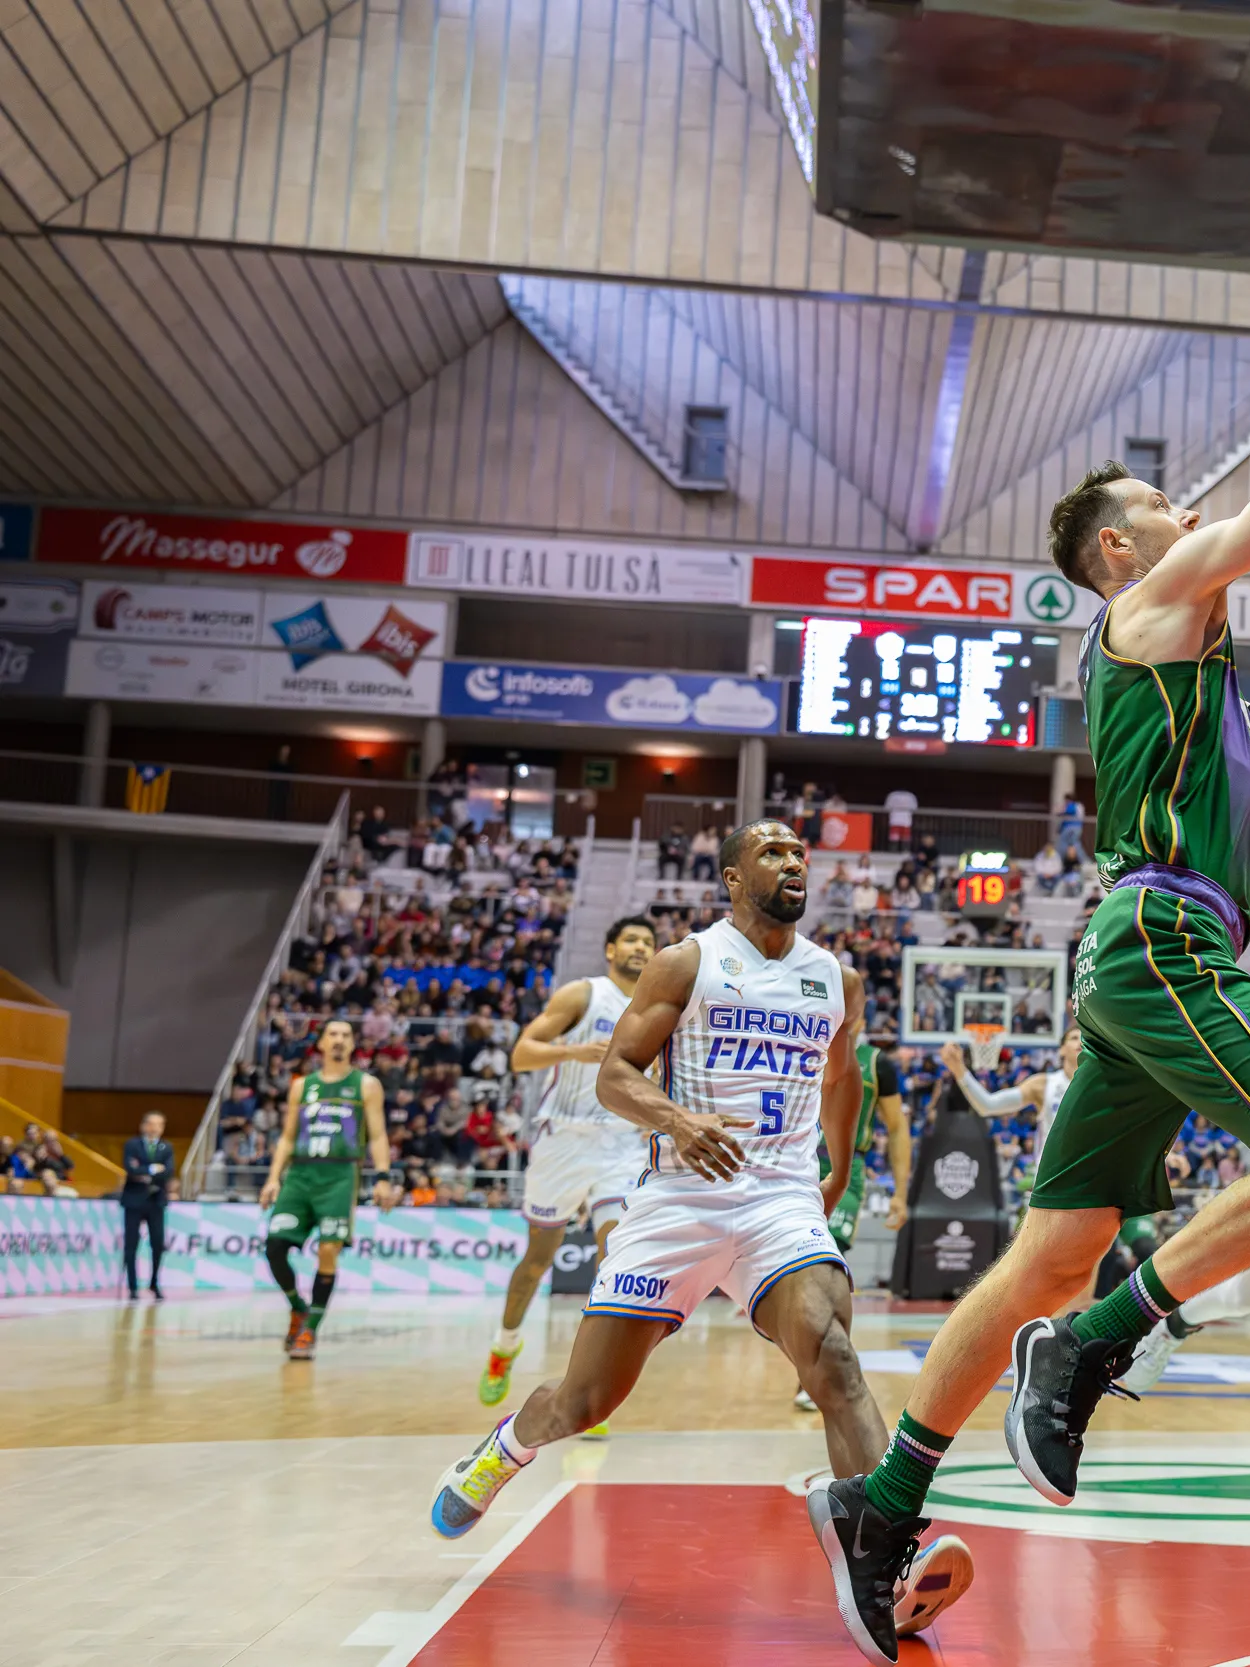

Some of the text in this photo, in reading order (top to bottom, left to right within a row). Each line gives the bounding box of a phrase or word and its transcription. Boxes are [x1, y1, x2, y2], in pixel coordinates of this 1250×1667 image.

[101, 515, 284, 568] Massegur
[465, 546, 662, 594] LLEAL TULSÀ
[824, 567, 1010, 612] SPAR
[191, 611, 254, 626] MOTOR
[374, 620, 419, 659] ibis
[281, 677, 414, 698] HOTEL GIRONA
[503, 671, 594, 697] infosoft
[967, 874, 1005, 904] 19
[1076, 931, 1097, 960] STA
[708, 1005, 832, 1043] GIRONA
[760, 1089, 786, 1137] 5
[613, 1273, 671, 1300] YOSOY
